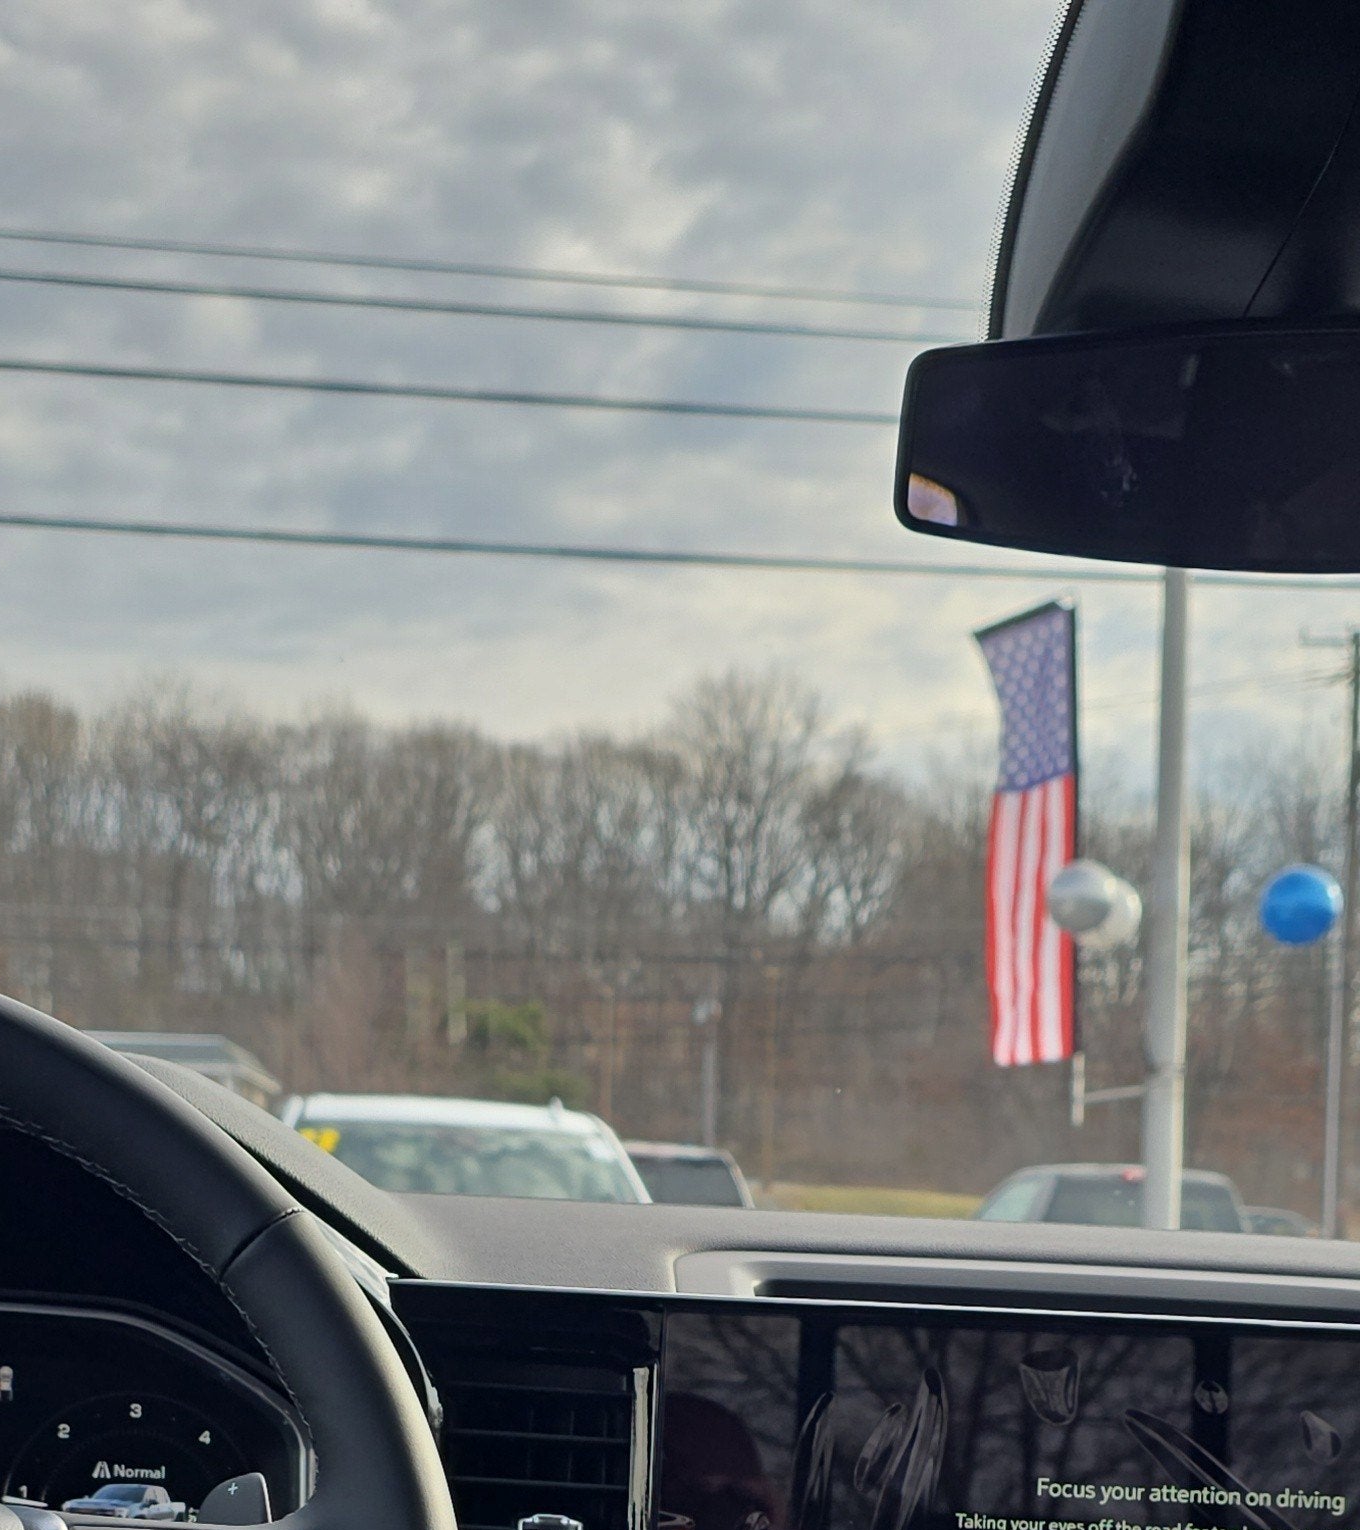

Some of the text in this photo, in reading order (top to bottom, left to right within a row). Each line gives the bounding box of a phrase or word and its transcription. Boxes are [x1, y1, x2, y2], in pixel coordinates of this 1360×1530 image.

[129, 1403, 142, 1419] 3
[57, 1423, 71, 1440] 2
[198, 1430, 211, 1445] 4
[113, 1464, 166, 1480] Normal
[1037, 1477, 1346, 1516] Focus your attention on driving
